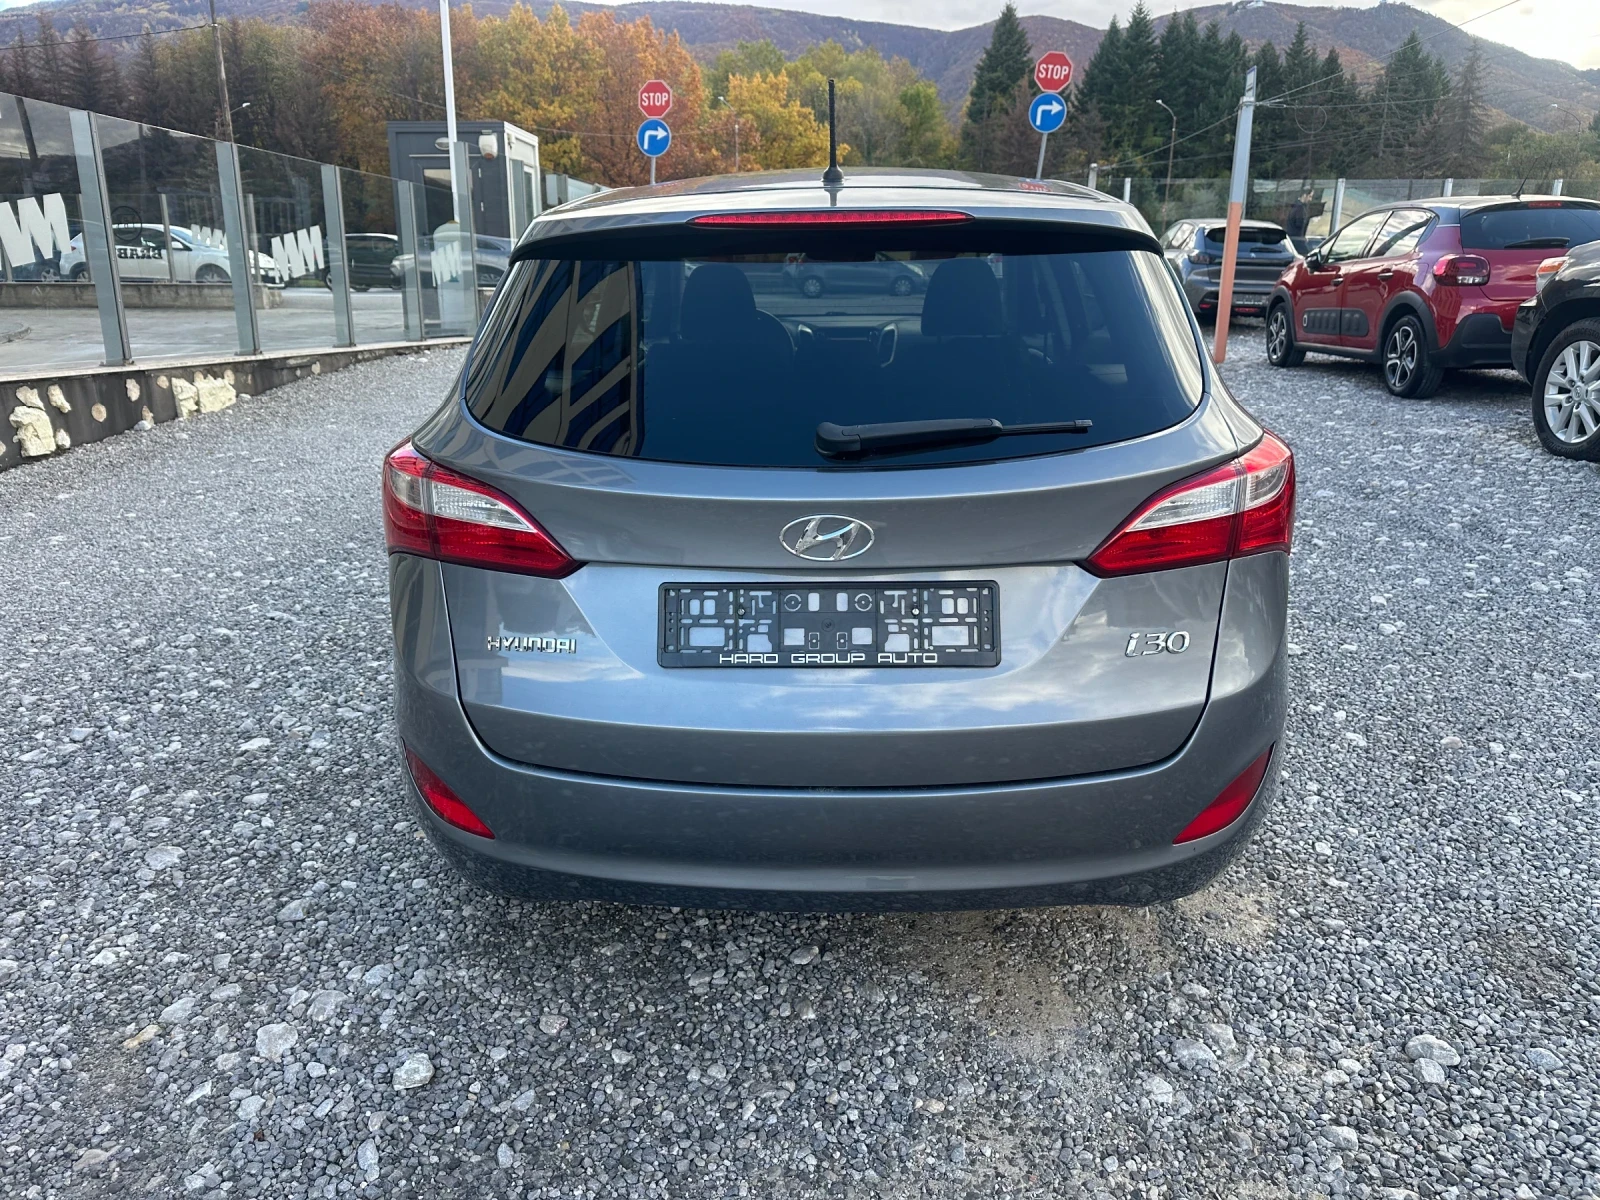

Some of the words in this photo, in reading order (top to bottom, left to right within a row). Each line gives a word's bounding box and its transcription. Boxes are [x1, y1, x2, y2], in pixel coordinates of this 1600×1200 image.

[1038, 63, 1070, 80] STOP
[641, 92, 669, 107] STOP
[486, 636, 577, 654] HYUNDAI
[1124, 630, 1191, 658] i30
[790, 652, 866, 664] GROUP
[877, 652, 938, 664] AUTO
